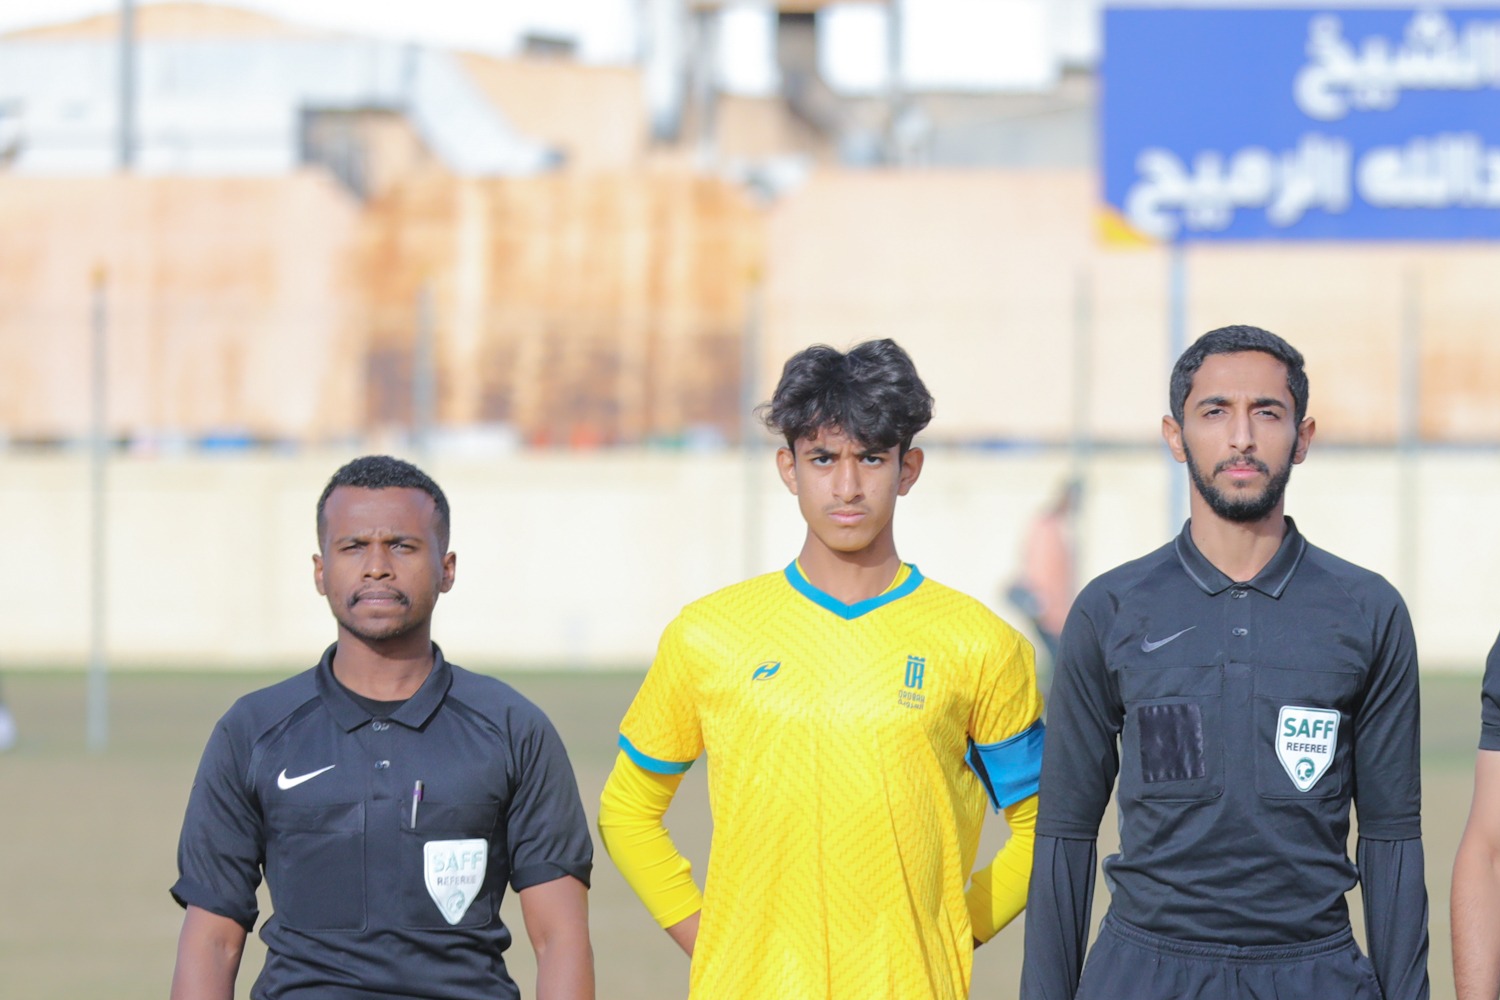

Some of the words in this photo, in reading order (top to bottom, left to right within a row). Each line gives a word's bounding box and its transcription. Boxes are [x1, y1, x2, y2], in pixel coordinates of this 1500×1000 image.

[1283, 717, 1335, 739] SAFF
[1286, 742, 1328, 754] REFEREE
[433, 851, 483, 873] SAFF
[437, 876, 477, 886] REFEREE
